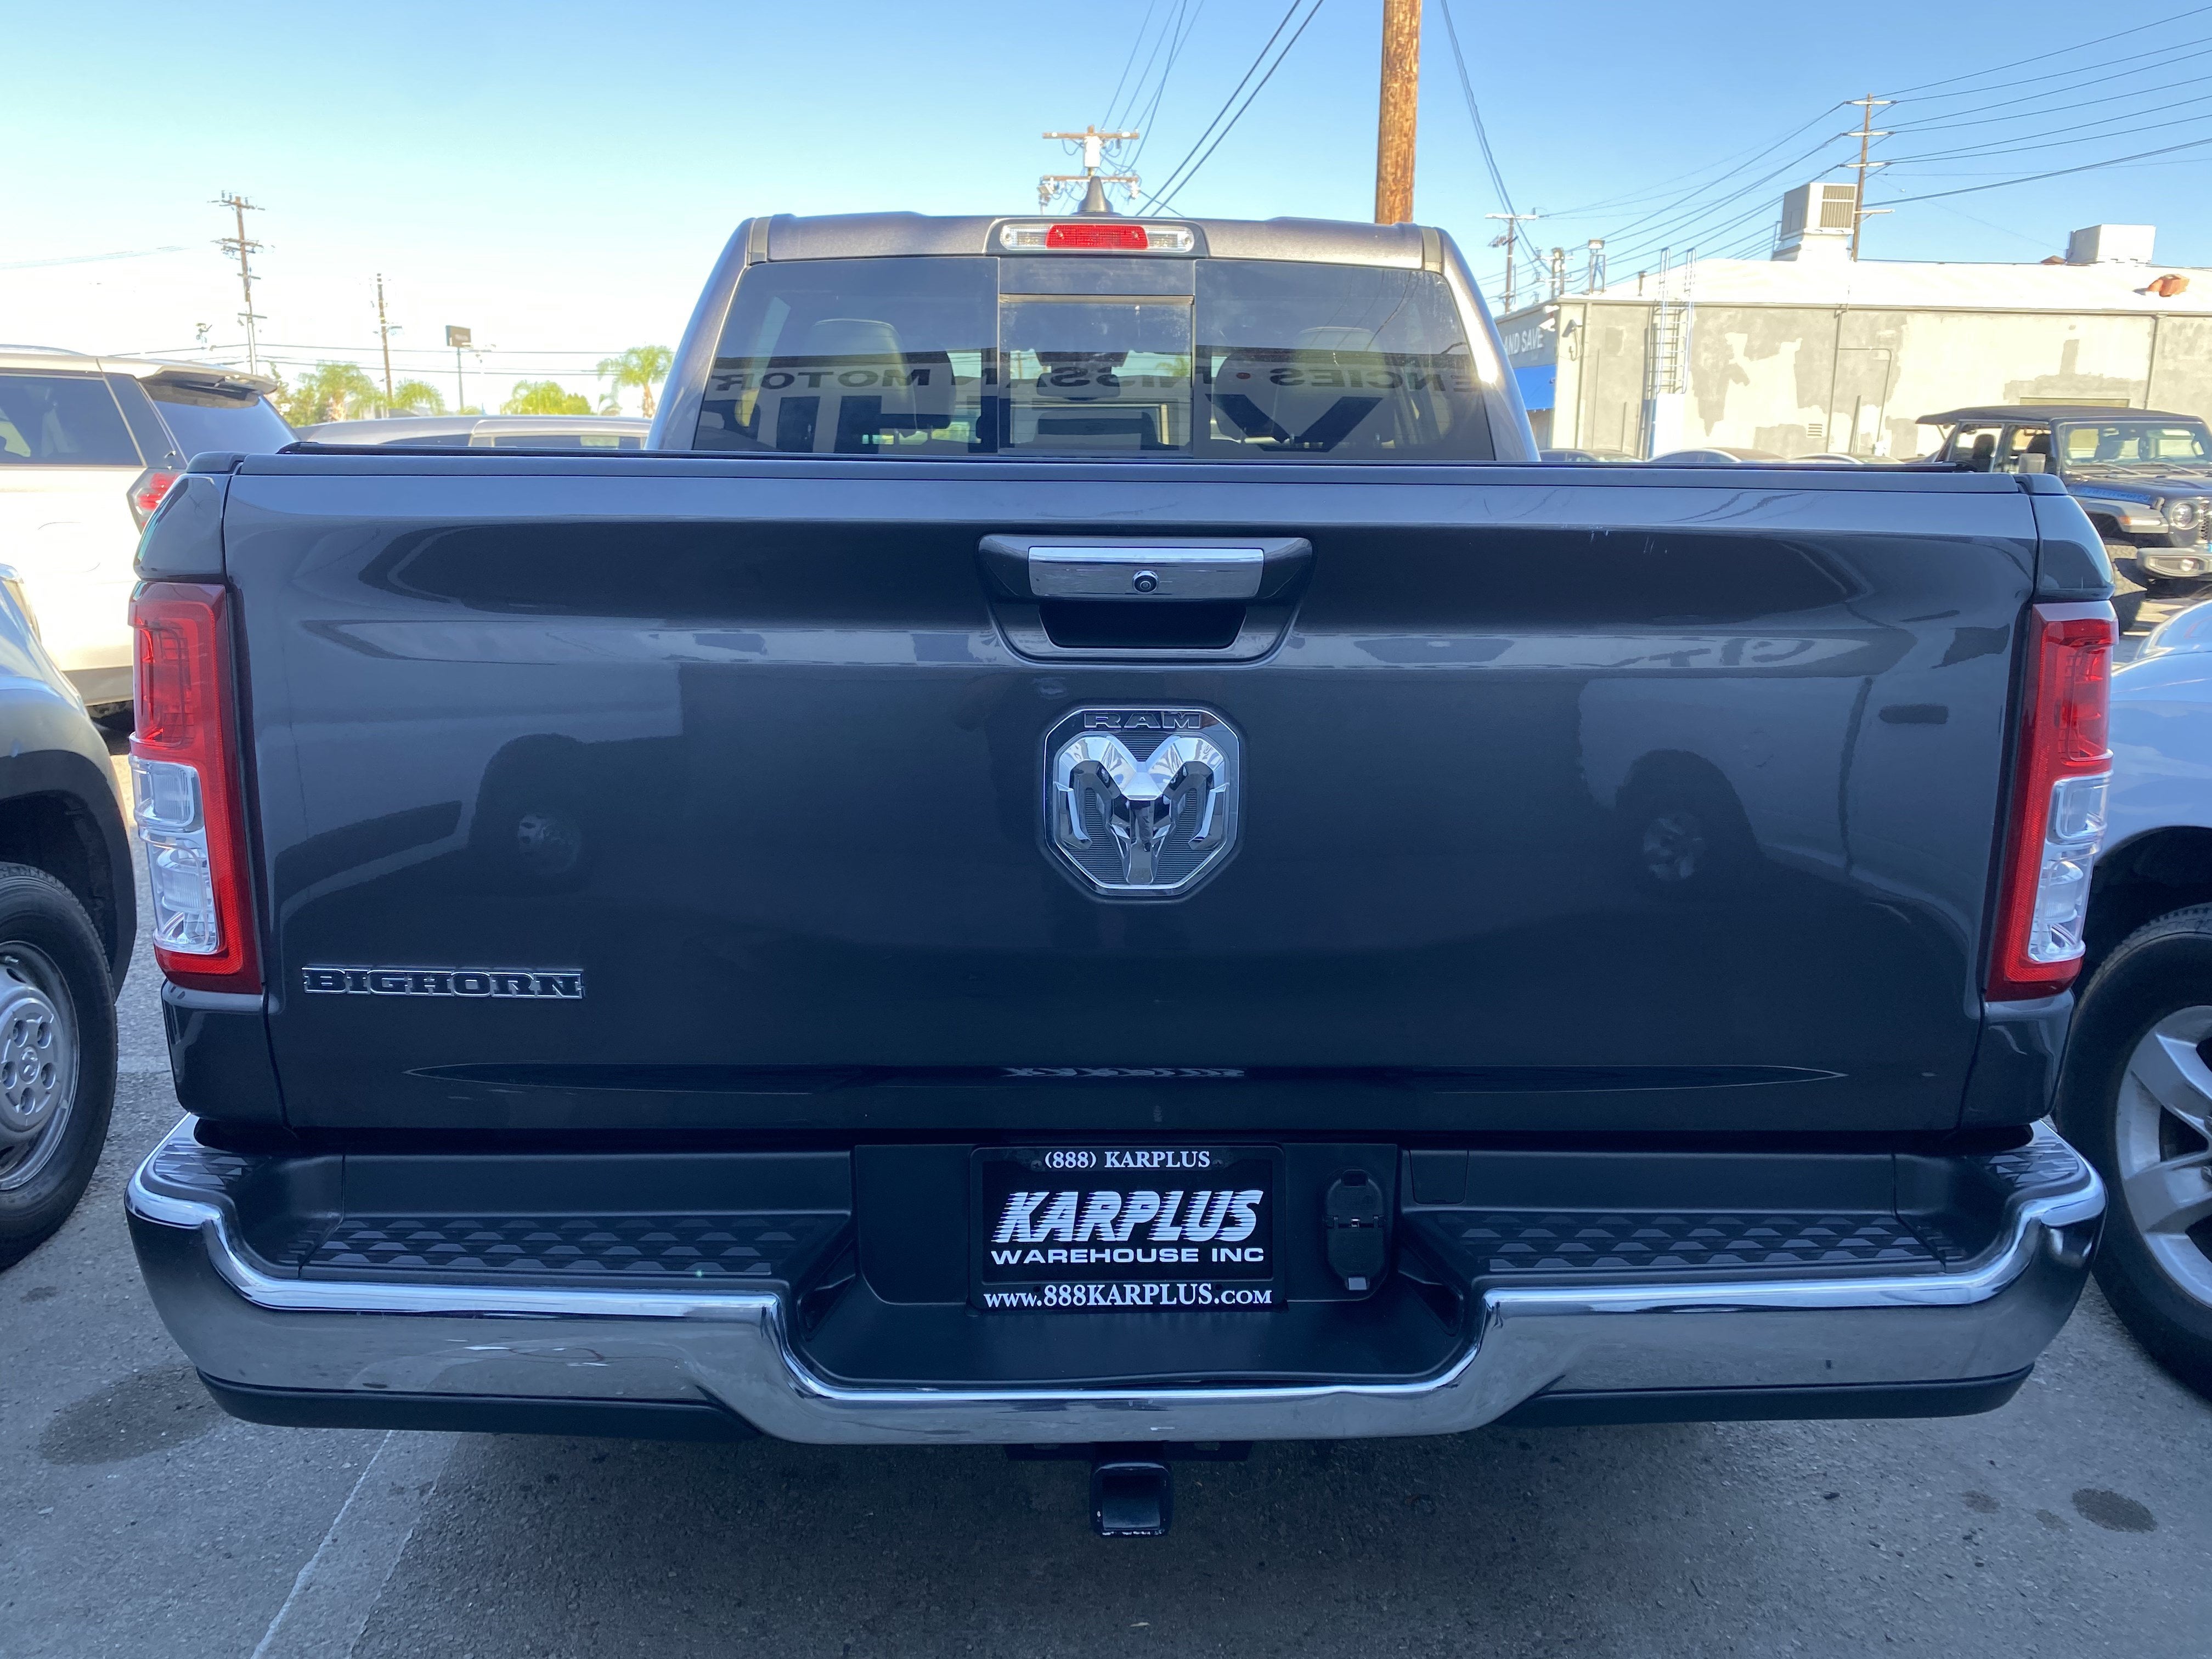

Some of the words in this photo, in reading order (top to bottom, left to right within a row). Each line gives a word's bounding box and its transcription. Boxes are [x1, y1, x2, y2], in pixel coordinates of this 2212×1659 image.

[1084, 713, 1201, 729] RAM
[302, 966, 585, 998] BIGHORN
[1045, 1151, 1097, 1169] (888)
[1104, 1151, 1210, 1168] KARPLUS
[991, 1190, 1263, 1243] KARPLUS
[991, 1248, 1199, 1264] WAREHOUSE
[1212, 1248, 1264, 1262] INC
